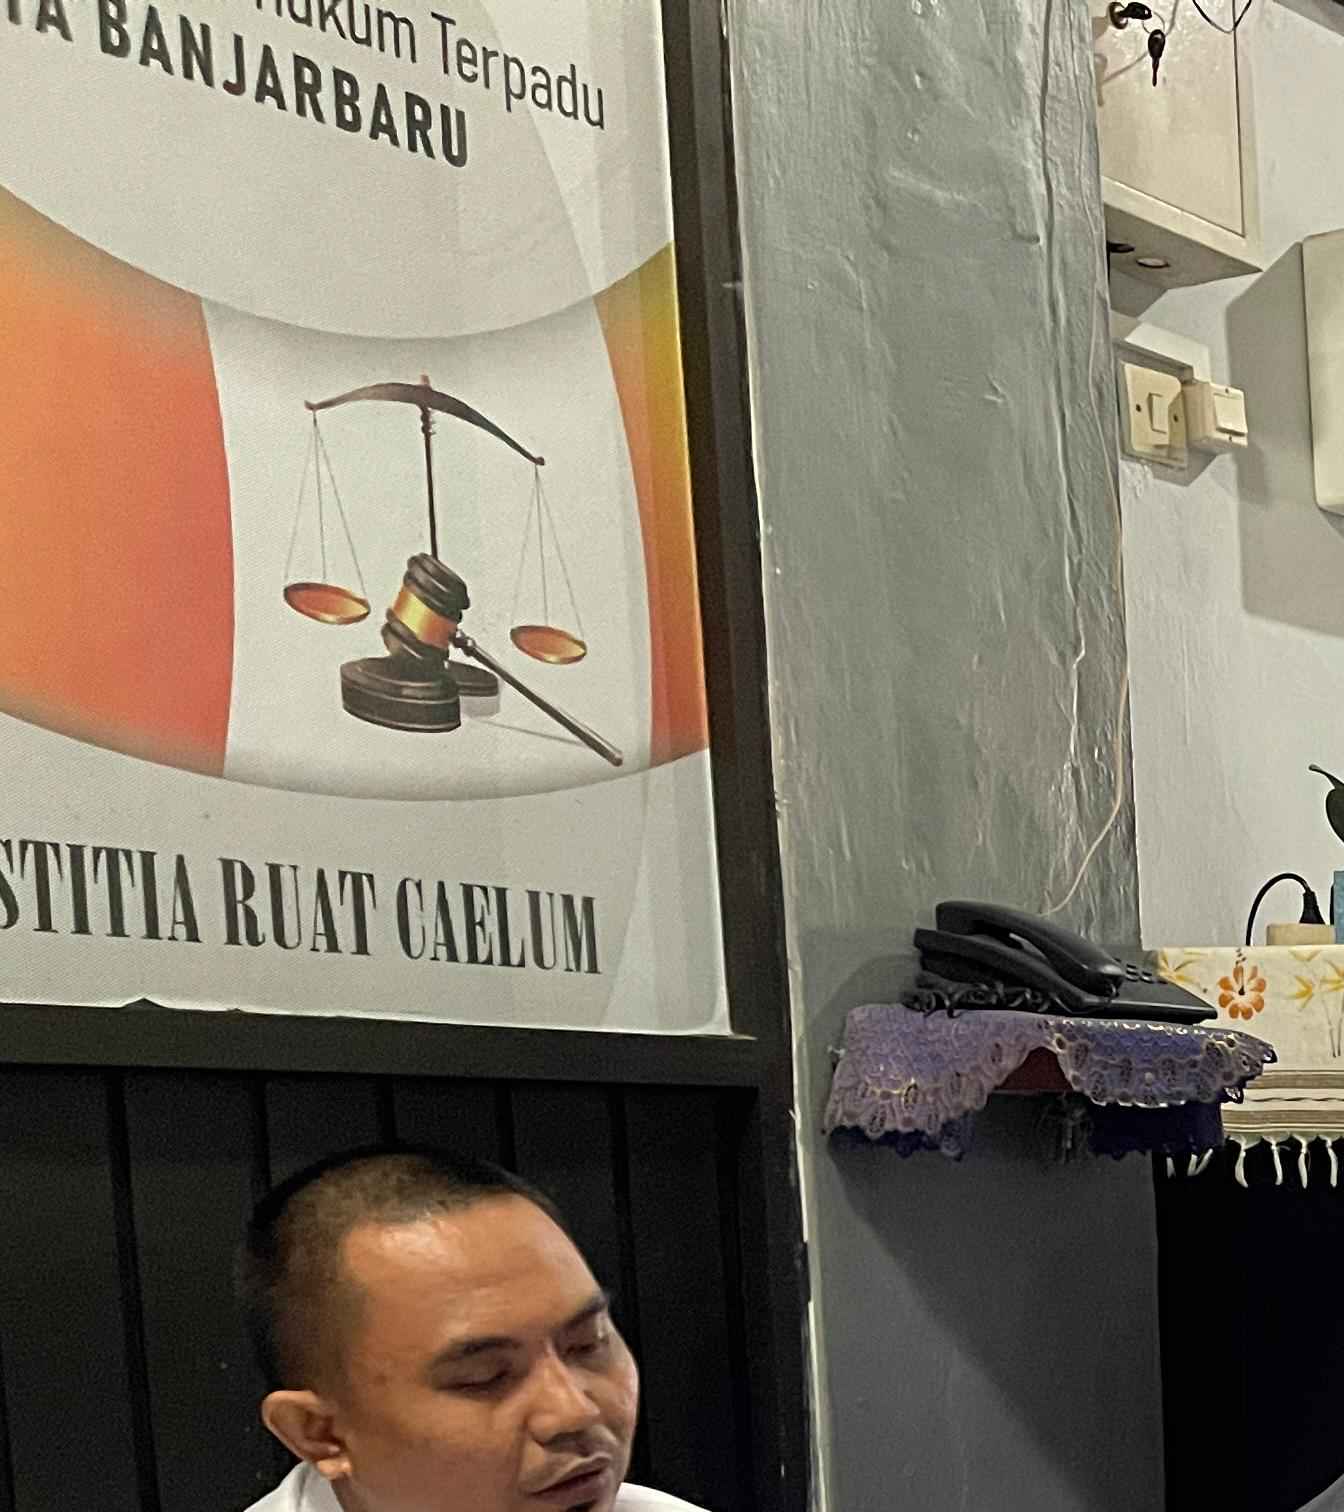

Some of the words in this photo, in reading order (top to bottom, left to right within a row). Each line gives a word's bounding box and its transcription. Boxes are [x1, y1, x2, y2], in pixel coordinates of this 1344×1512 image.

[99, 0, 468, 168] BANJARBARU
[256, 0, 416, 63] ukum
[431, 12, 605, 130] Terpadu
[217, 857, 377, 956] RUAT
[396, 877, 603, 975] CAELUM
